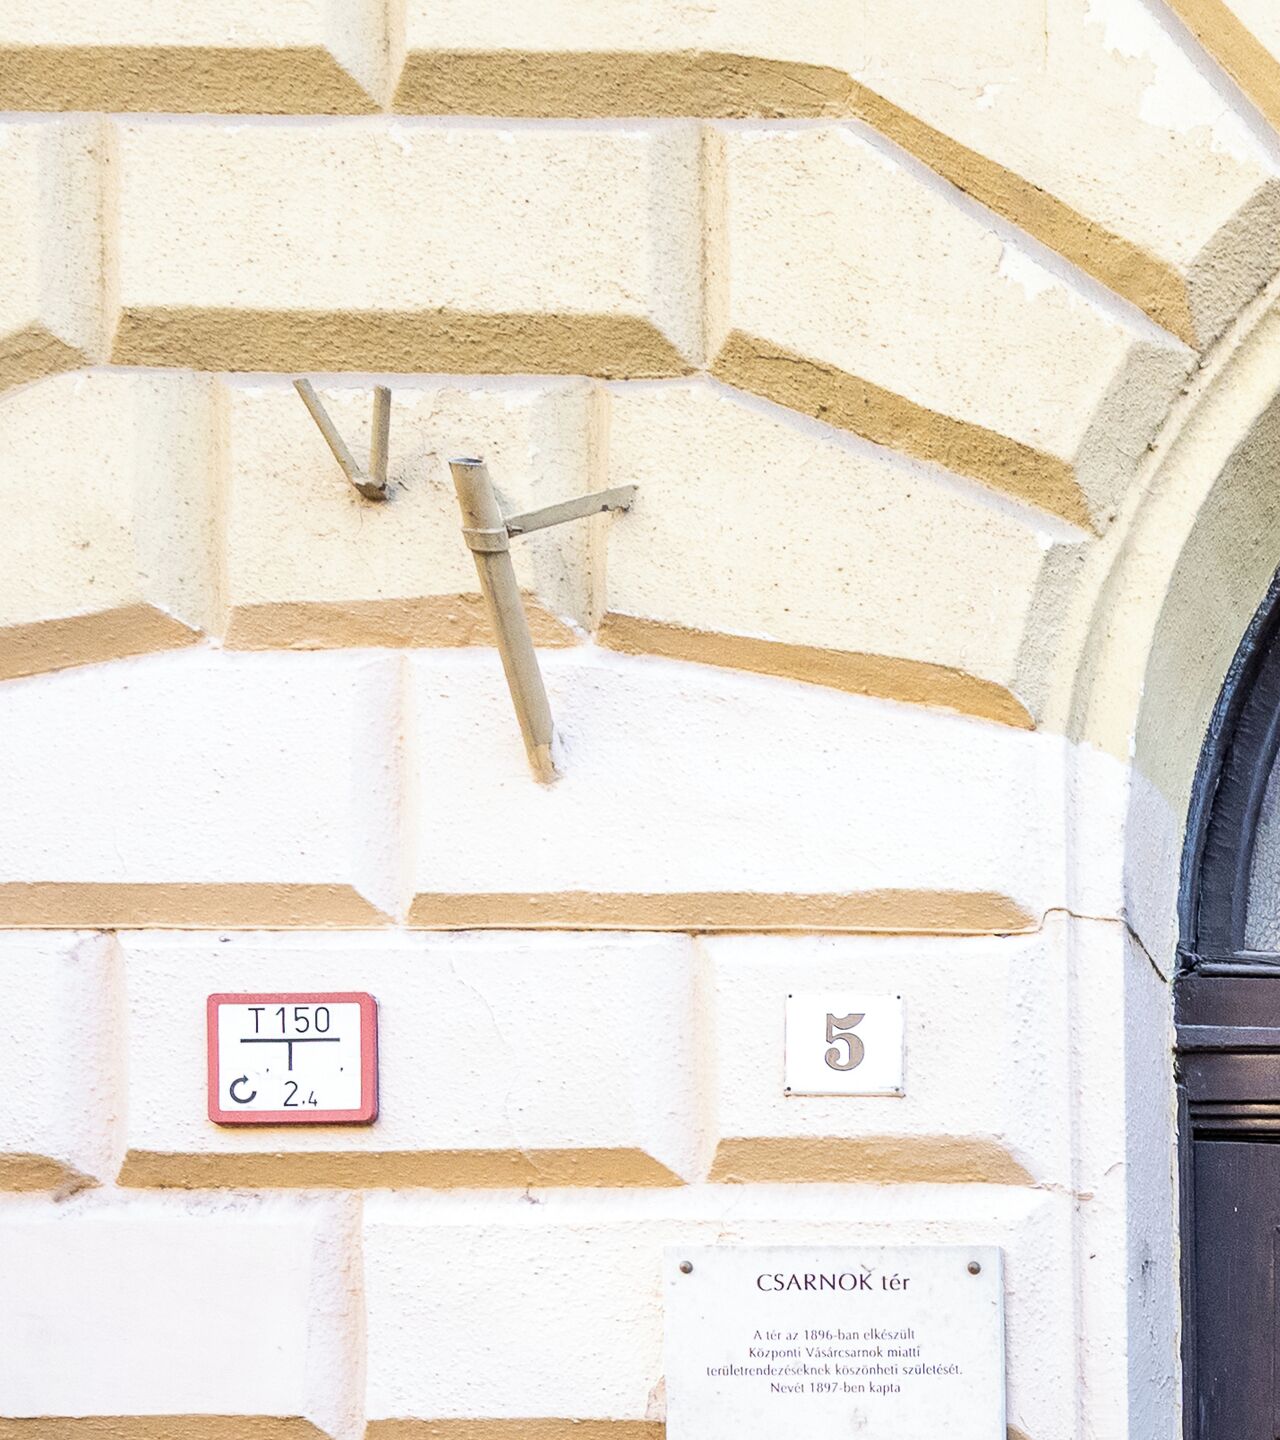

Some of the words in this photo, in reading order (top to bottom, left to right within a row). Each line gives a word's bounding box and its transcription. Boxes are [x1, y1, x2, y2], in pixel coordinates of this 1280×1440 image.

[824, 1013, 866, 1072] 5
[283, 1080, 318, 1107] 2.4
[756, 1272, 873, 1292] CSARNOK
[881, 1272, 911, 1291] tér
[753, 1329, 763, 1341] A
[766, 1329, 782, 1341] tér
[785, 1332, 799, 1341] az
[804, 1328, 860, 1341] 1896-ban
[863, 1327, 915, 1341] elkészült
[748, 1346, 801, 1362] Központi
[805, 1345, 884, 1359] Vásárcsarnok
[887, 1345, 921, 1358] miatti
[706, 1363, 831, 1377] területrendezéseknek
[835, 1363, 898, 1376] köszönheti
[902, 1362, 963, 1376] születését.
[770, 1382, 805, 1394] Nevét
[810, 1381, 865, 1393] 1897-ben
[869, 1380, 901, 1397] kapta
